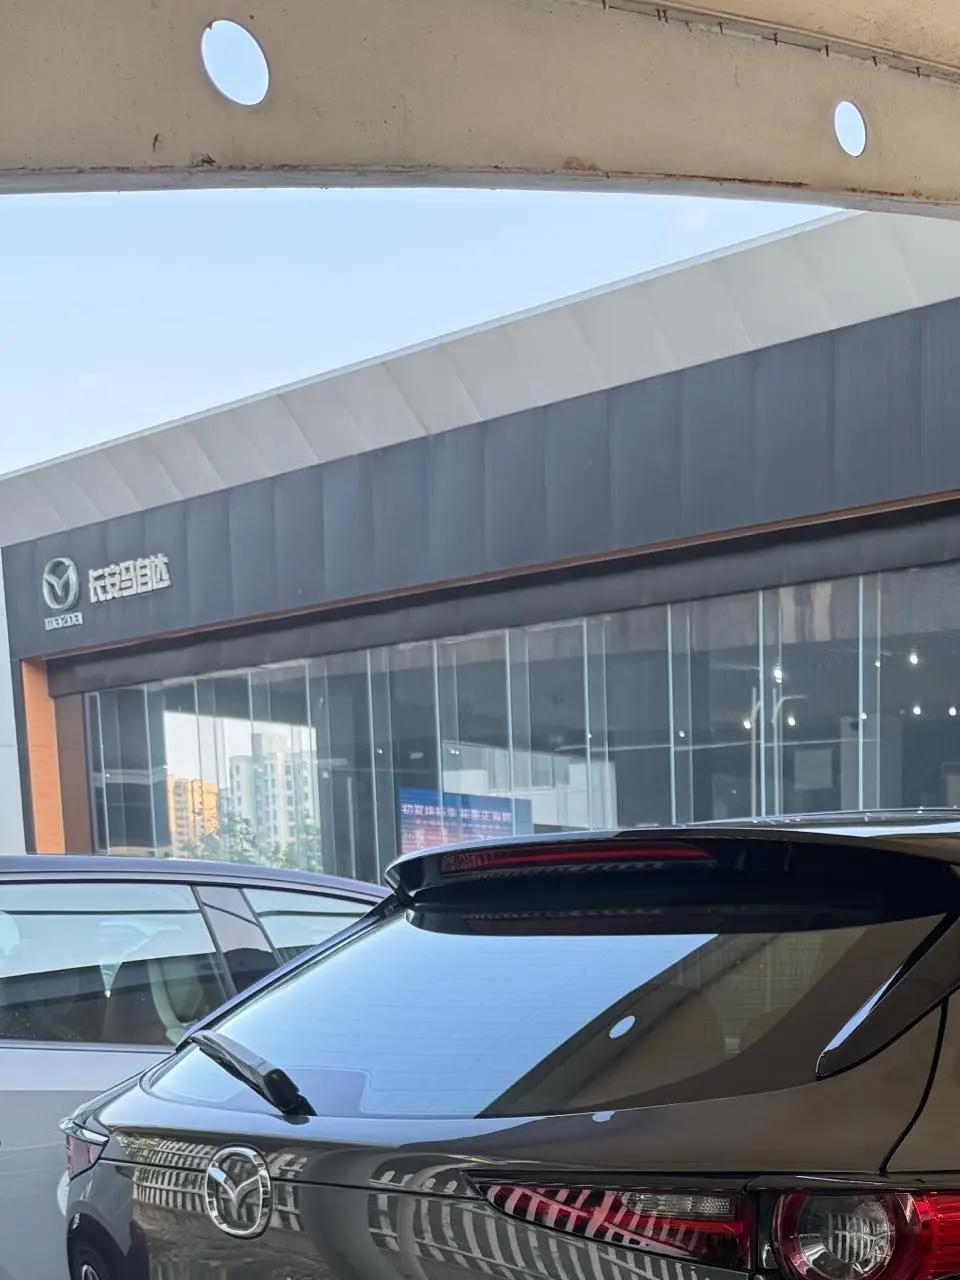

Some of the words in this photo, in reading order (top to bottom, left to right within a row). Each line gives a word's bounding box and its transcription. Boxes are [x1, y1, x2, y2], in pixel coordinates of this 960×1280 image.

[88, 553, 171, 603] 长安马自达
